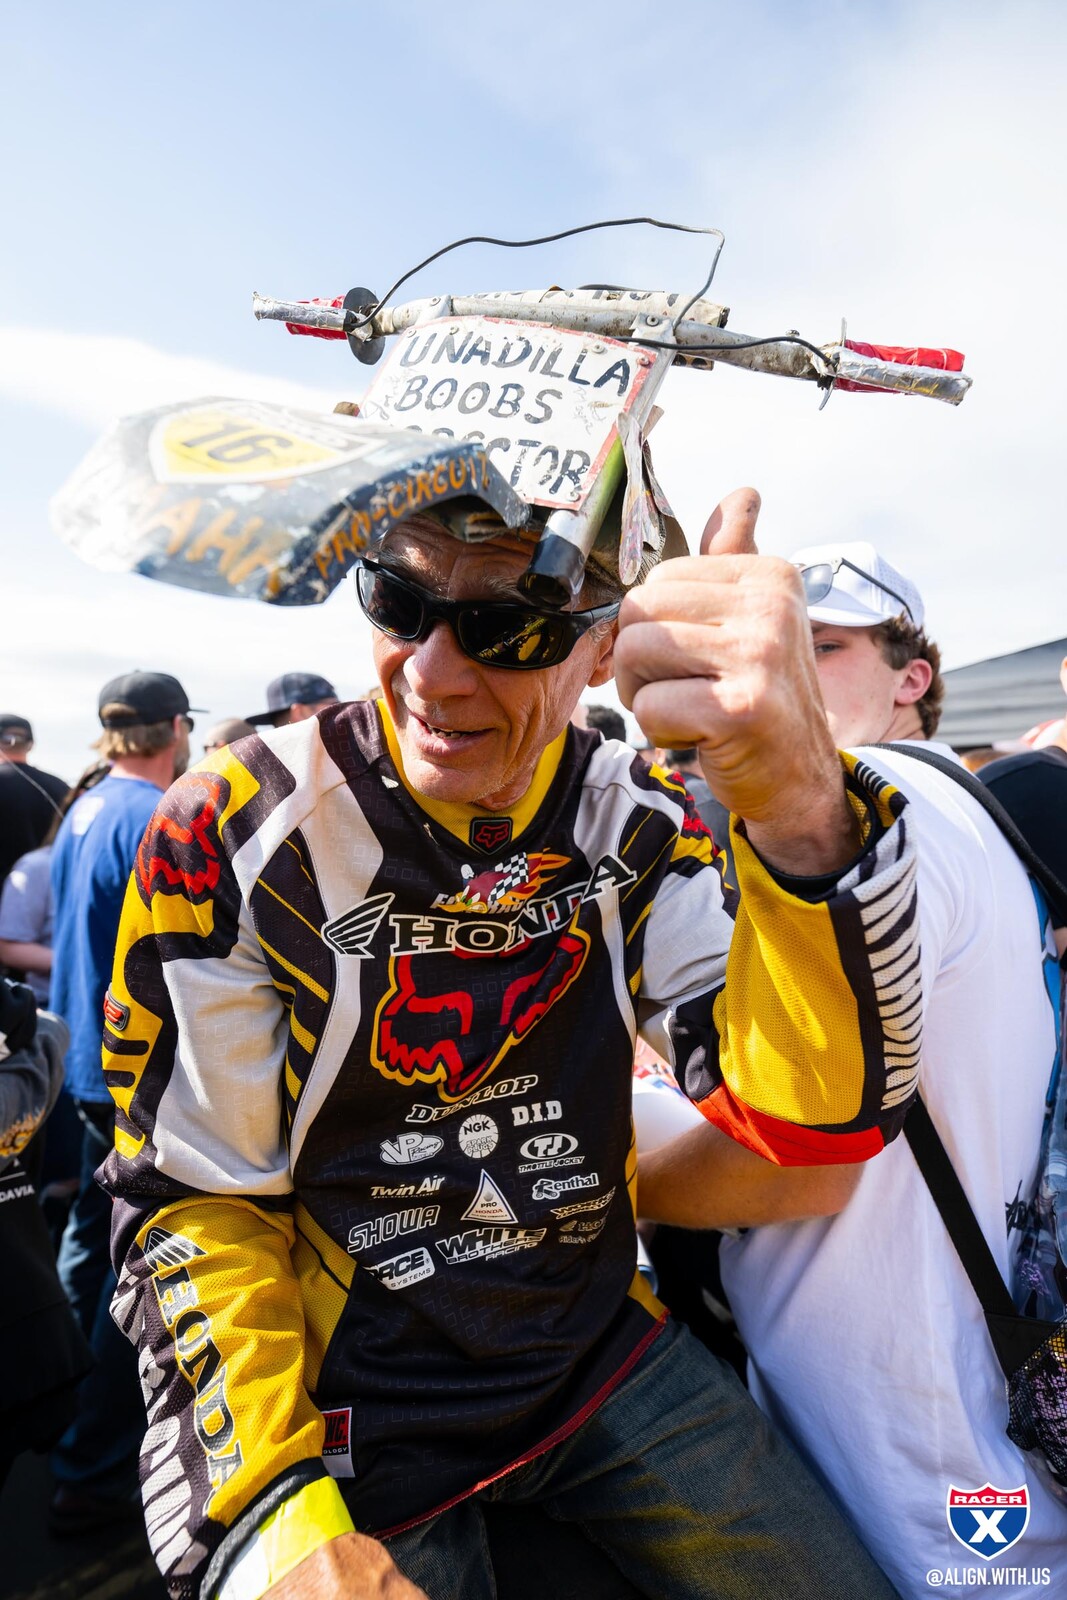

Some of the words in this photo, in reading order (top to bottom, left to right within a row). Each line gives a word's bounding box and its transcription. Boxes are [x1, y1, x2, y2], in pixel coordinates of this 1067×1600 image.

[399, 331, 631, 396] UNADILLA
[394, 374, 564, 424] BOOBS
[180, 419, 294, 464] 16
[389, 854, 638, 957] HONDA
[405, 1074, 539, 1123] DUNLOP
[511, 1100, 563, 1126] D.I.D
[463, 1121, 491, 1135] NGK
[380, 1132, 424, 1164] VP
[553, 1156, 585, 1168] JOCKEY
[370, 1184, 416, 1197] Twin
[416, 1175, 446, 1195] Air
[532, 1173, 600, 1200] Renthal
[347, 1205, 441, 1254] SHOWA
[391, 1267, 432, 1288] SYSTEMS
